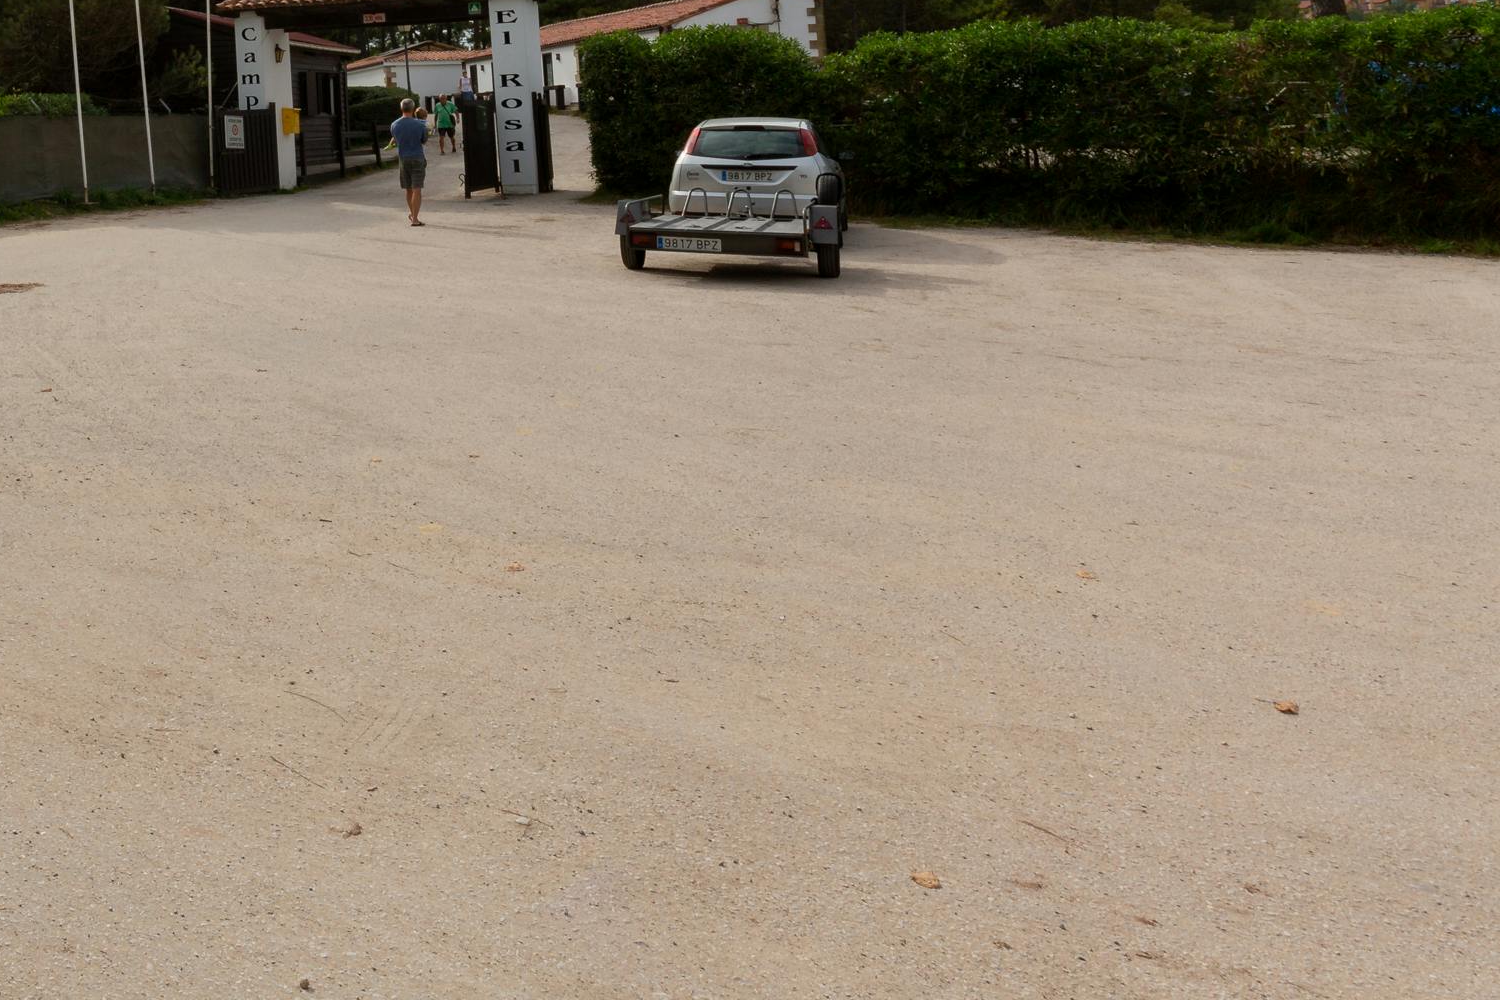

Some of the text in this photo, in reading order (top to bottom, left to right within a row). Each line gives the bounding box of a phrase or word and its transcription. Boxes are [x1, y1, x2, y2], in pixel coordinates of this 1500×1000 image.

[495, 9, 525, 173] El Rosal
[728, 170, 773, 181] 9817 BPZ
[665, 238, 719, 250] 9817 BPZ
